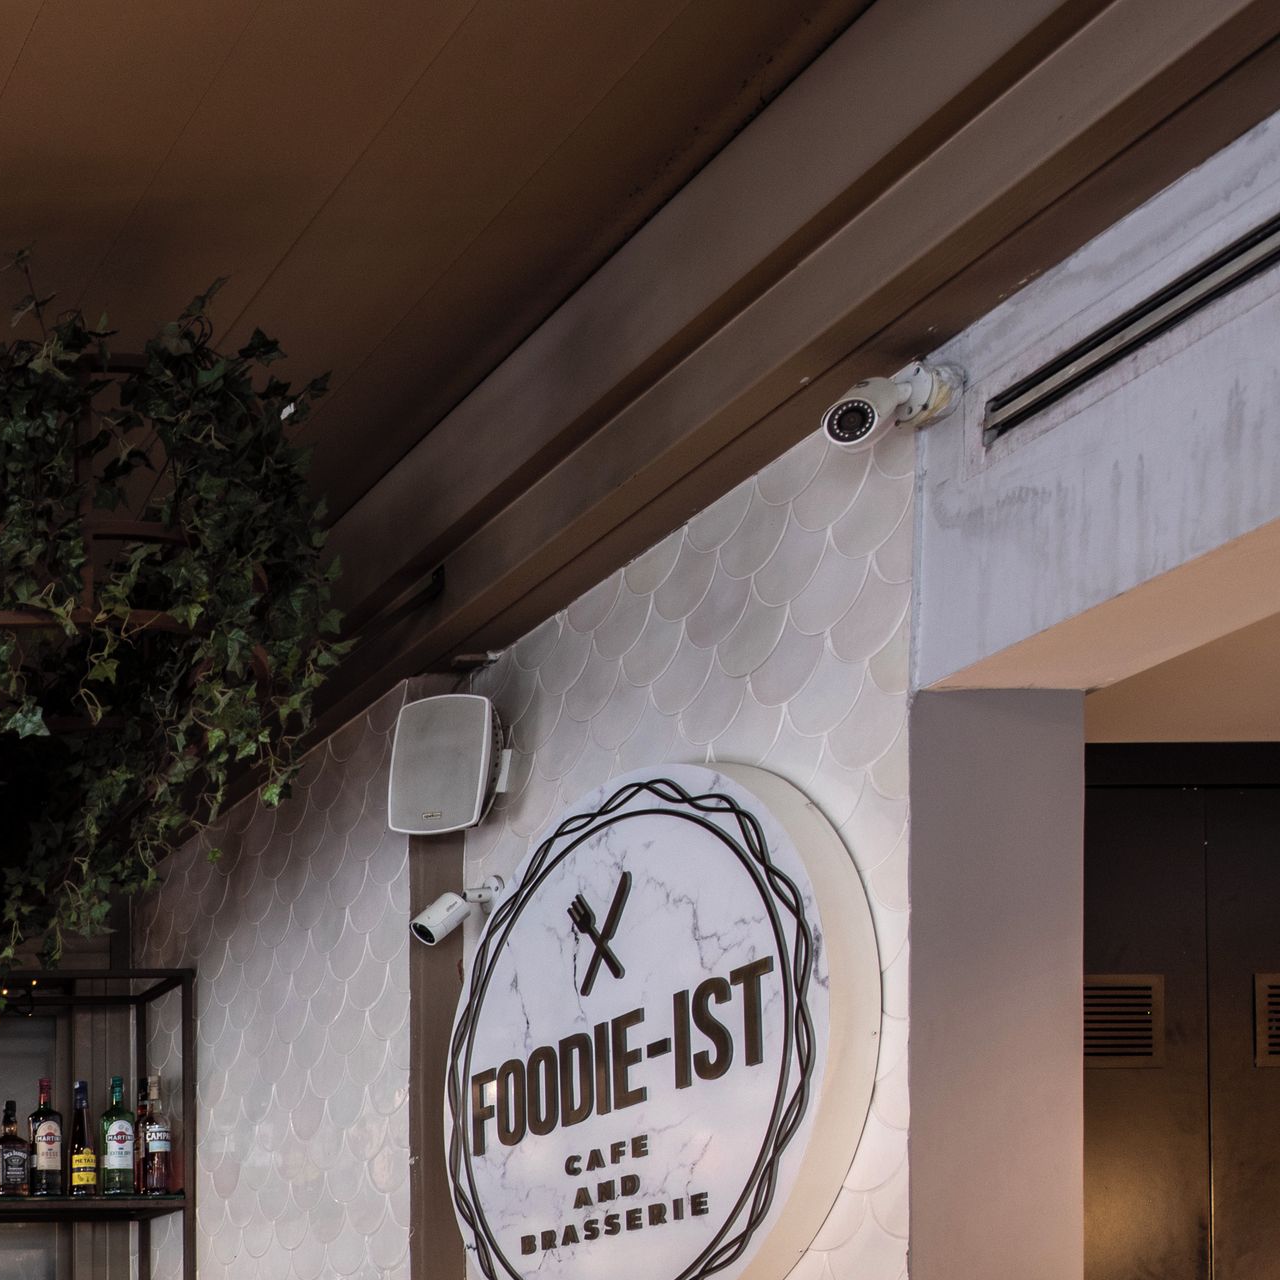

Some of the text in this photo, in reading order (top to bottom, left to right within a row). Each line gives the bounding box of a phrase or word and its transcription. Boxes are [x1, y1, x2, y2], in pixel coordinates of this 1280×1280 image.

[472, 955, 773, 1157] FOODIE-IST
[564, 1134, 650, 1177] CAFE
[572, 1173, 641, 1210] AND
[520, 1191, 710, 1256] BRASSERIE
